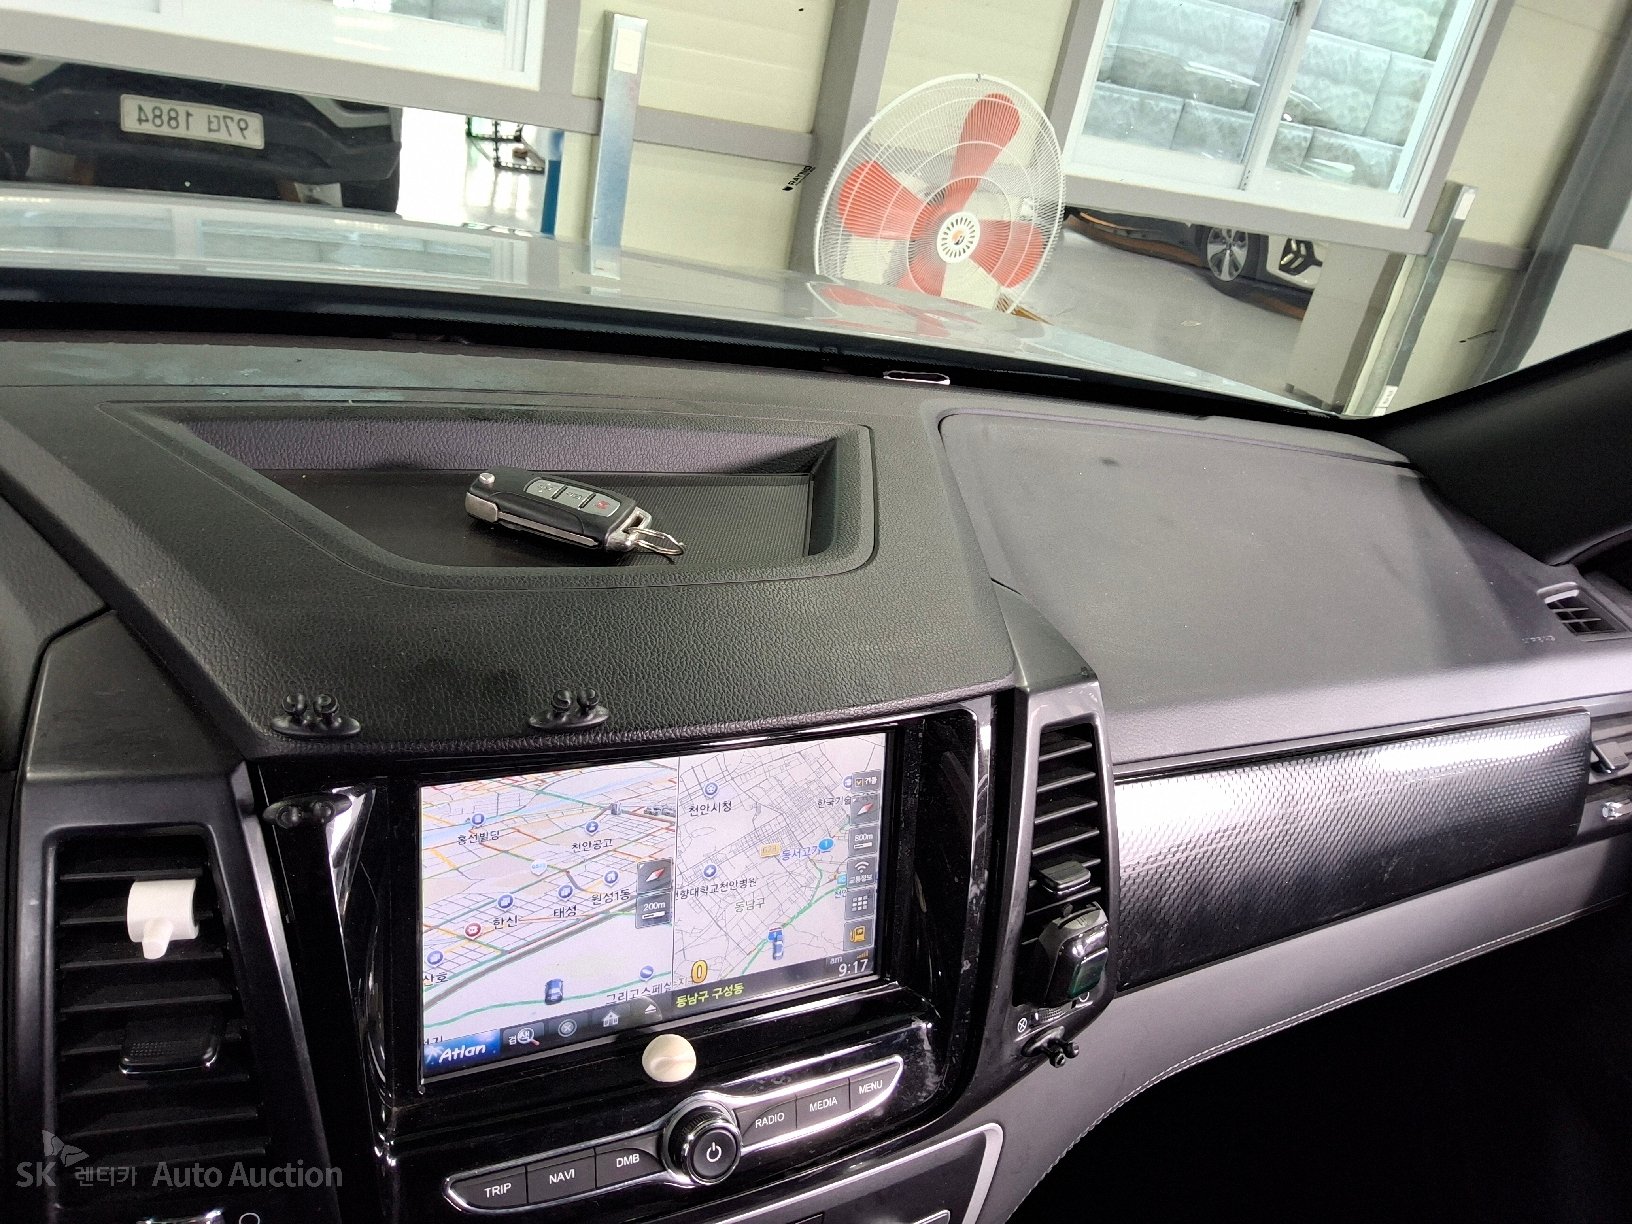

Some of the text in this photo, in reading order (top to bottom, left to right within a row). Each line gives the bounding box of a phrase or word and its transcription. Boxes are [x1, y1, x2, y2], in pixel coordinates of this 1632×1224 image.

[688, 800, 732, 817] 천안시청
[571, 838, 613, 854] 천안공고
[591, 888, 630, 906] 원성1동
[735, 897, 765, 913] 동남구
[553, 904, 577, 918] 태성
[643, 901, 666, 912] 200m
[493, 914, 518, 930] 한신
[829, 956, 843, 965] am
[838, 959, 869, 977] 9:17
[690, 959, 708, 984] 0
[675, 982, 745, 1008] 동남구 구성동
[508, 1029, 531, 1046] 검색
[438, 1043, 486, 1064] Atlan
[858, 1080, 883, 1095] MENU
[809, 1096, 838, 1112] MEDIA
[755, 1112, 785, 1129] RADIO
[616, 1153, 640, 1168] DMB
[549, 1168, 575, 1184] NAVI
[484, 1182, 512, 1198] TRIP
